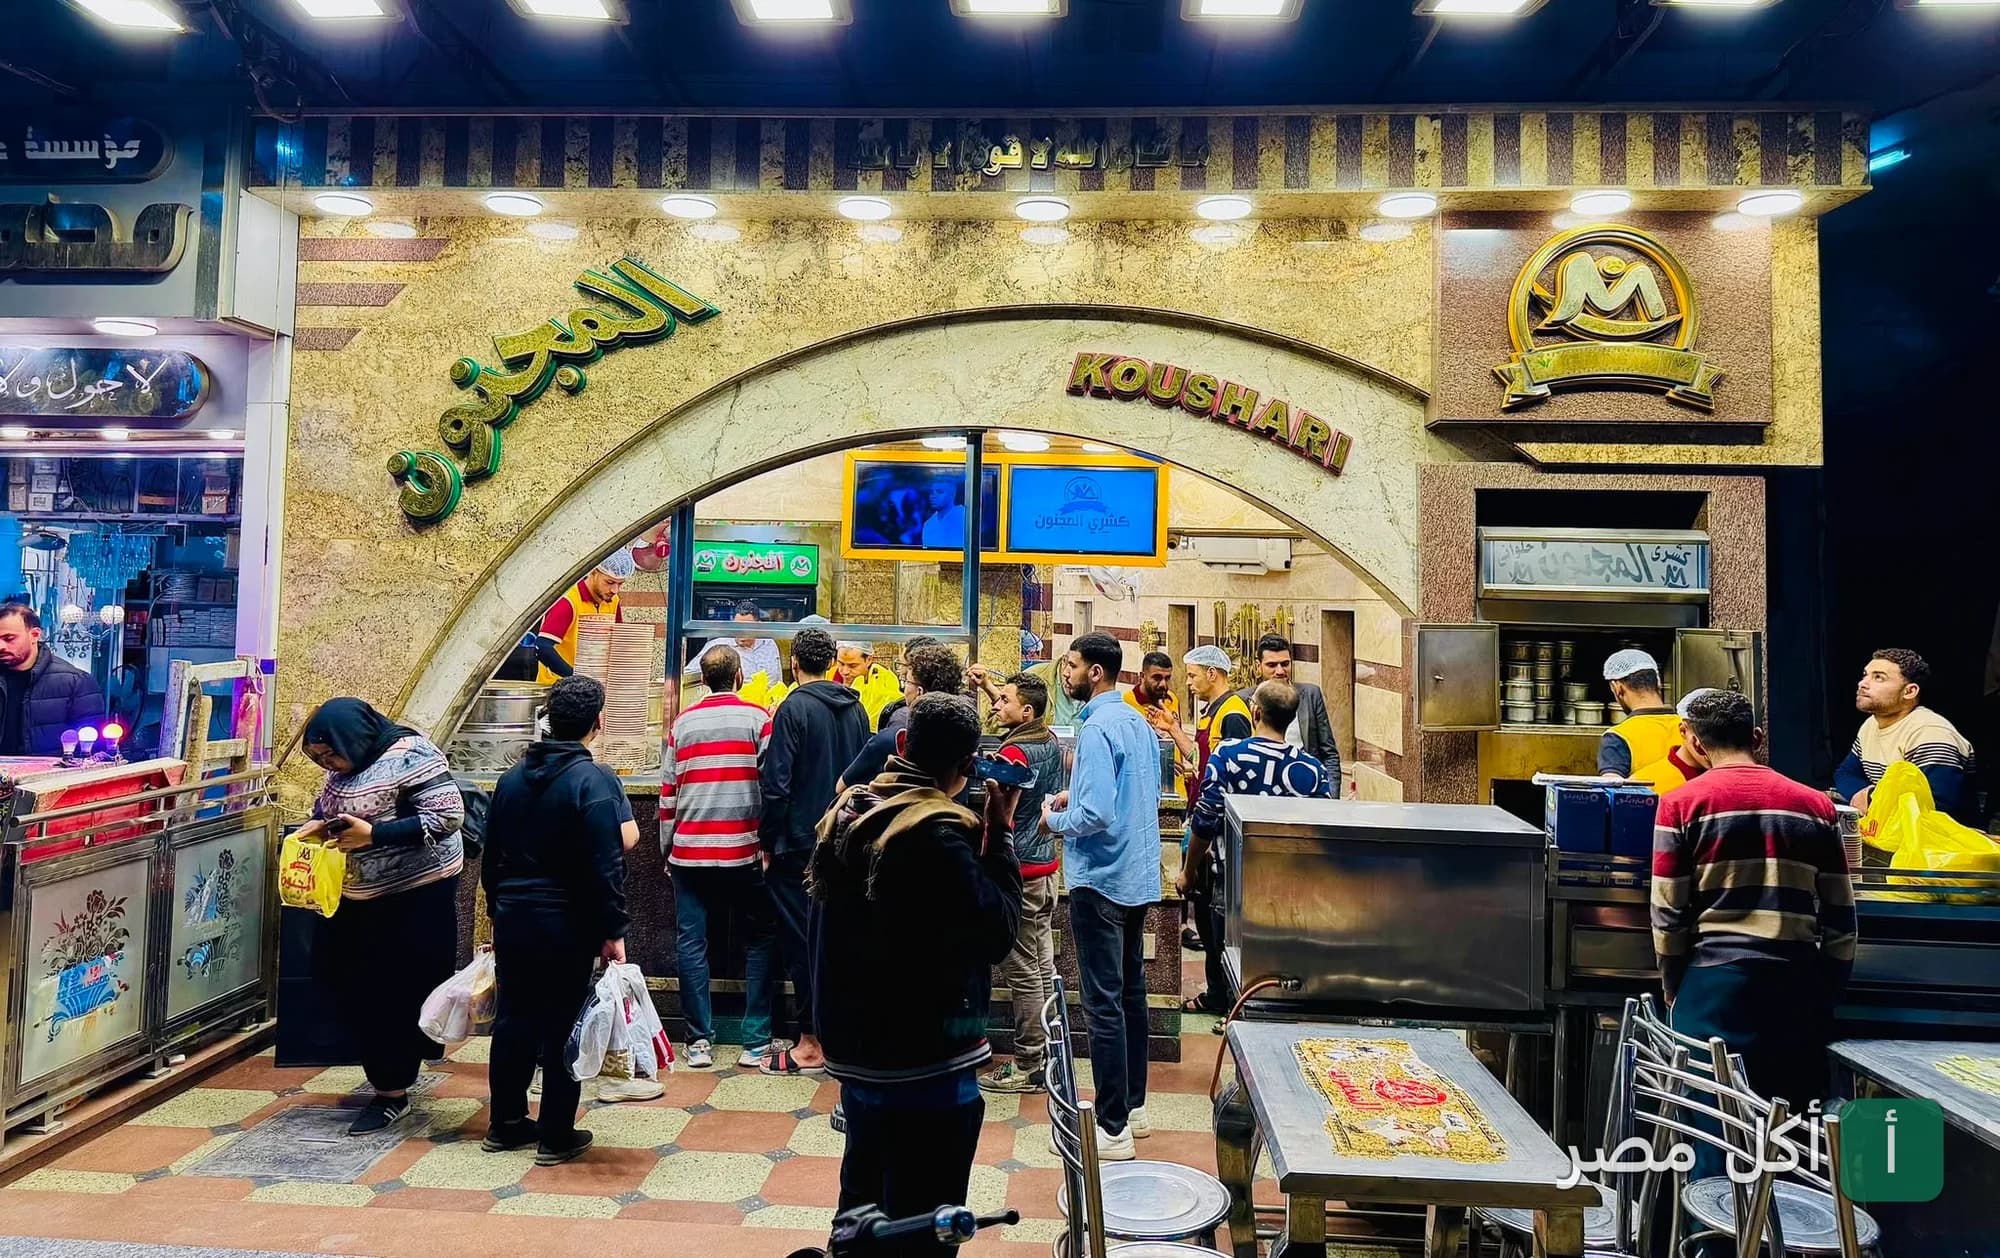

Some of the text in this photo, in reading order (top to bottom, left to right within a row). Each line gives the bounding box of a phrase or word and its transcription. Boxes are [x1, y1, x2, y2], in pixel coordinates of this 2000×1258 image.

[23, 126, 142, 169] مؤسسة
[386, 255, 721, 525] المجنون
[1065, 351, 1354, 477] KOUSHARI
[1087, 512, 1131, 535] كشري
[723, 551, 783, 575] المجنون
